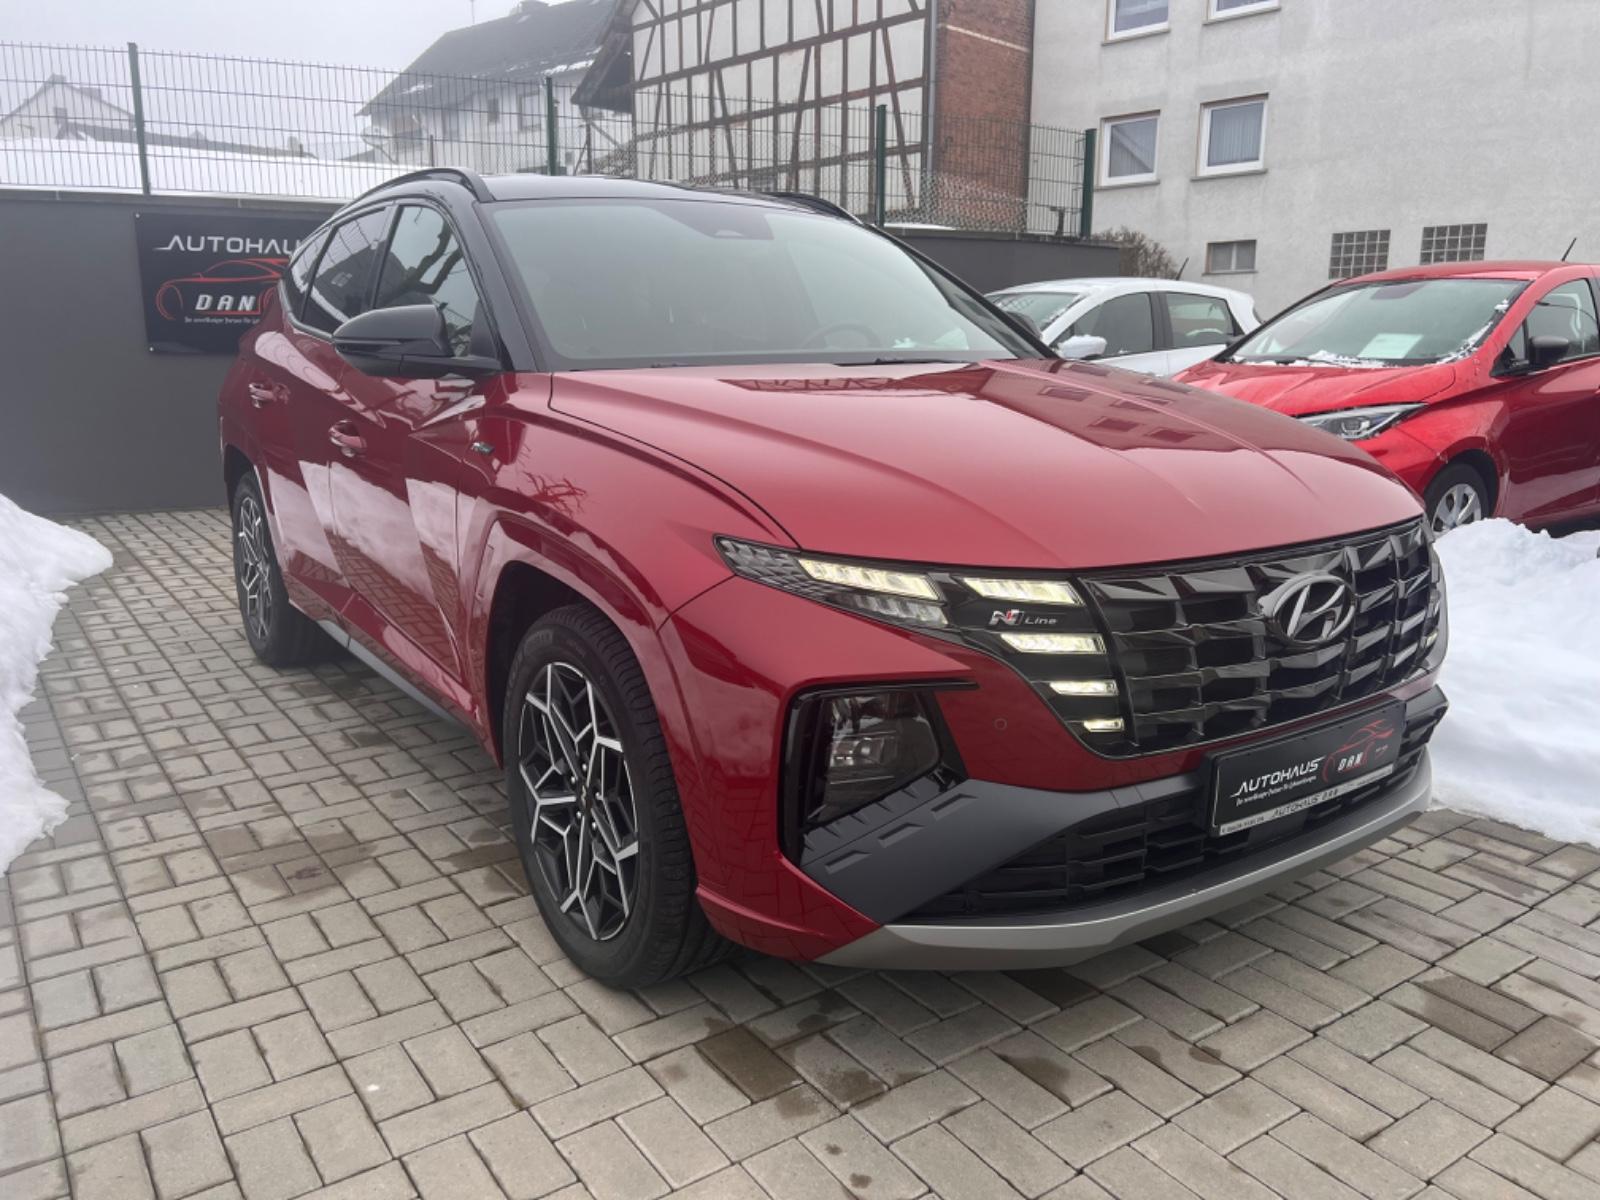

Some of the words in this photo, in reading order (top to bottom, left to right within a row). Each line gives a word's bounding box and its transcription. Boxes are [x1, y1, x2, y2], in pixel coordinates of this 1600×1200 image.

[154, 235, 300, 255] AUTOHAU
[195, 294, 256, 311] DAN
[1230, 755, 1325, 797] AUTOHAUS
